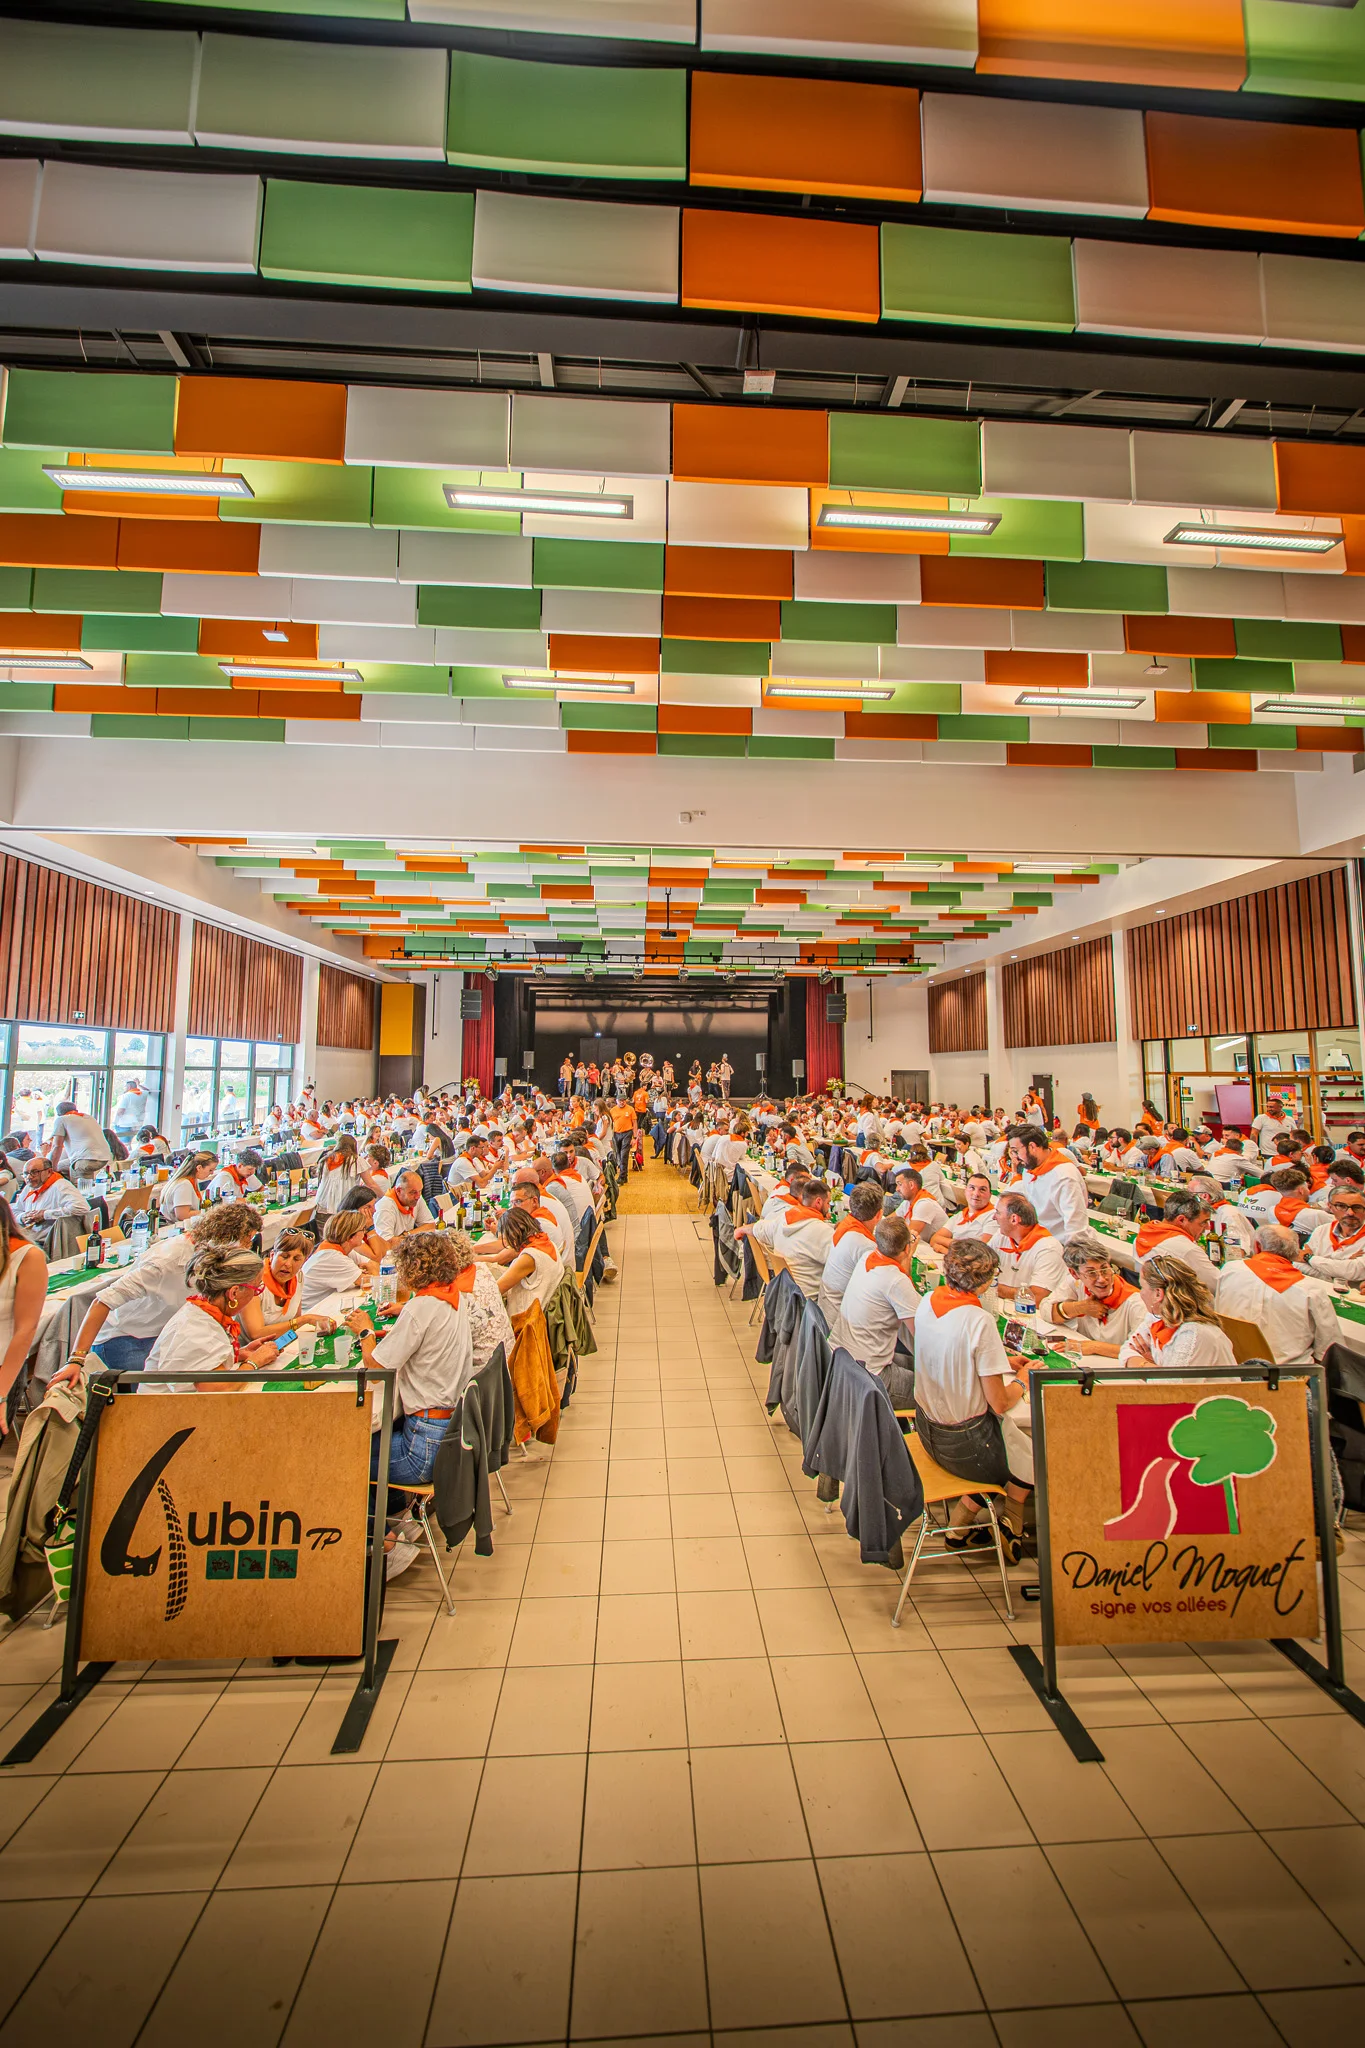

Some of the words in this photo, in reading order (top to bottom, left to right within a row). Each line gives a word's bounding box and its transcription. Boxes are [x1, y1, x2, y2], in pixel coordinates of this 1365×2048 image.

[305, 1527, 343, 1551] TP
[1062, 1541, 1168, 1596] Daniel
[1173, 1539, 1306, 1618] Moquet
[1090, 1600, 1137, 1619] signe
[1142, 1601, 1173, 1614] vos
[1176, 1596, 1227, 1613] allées
